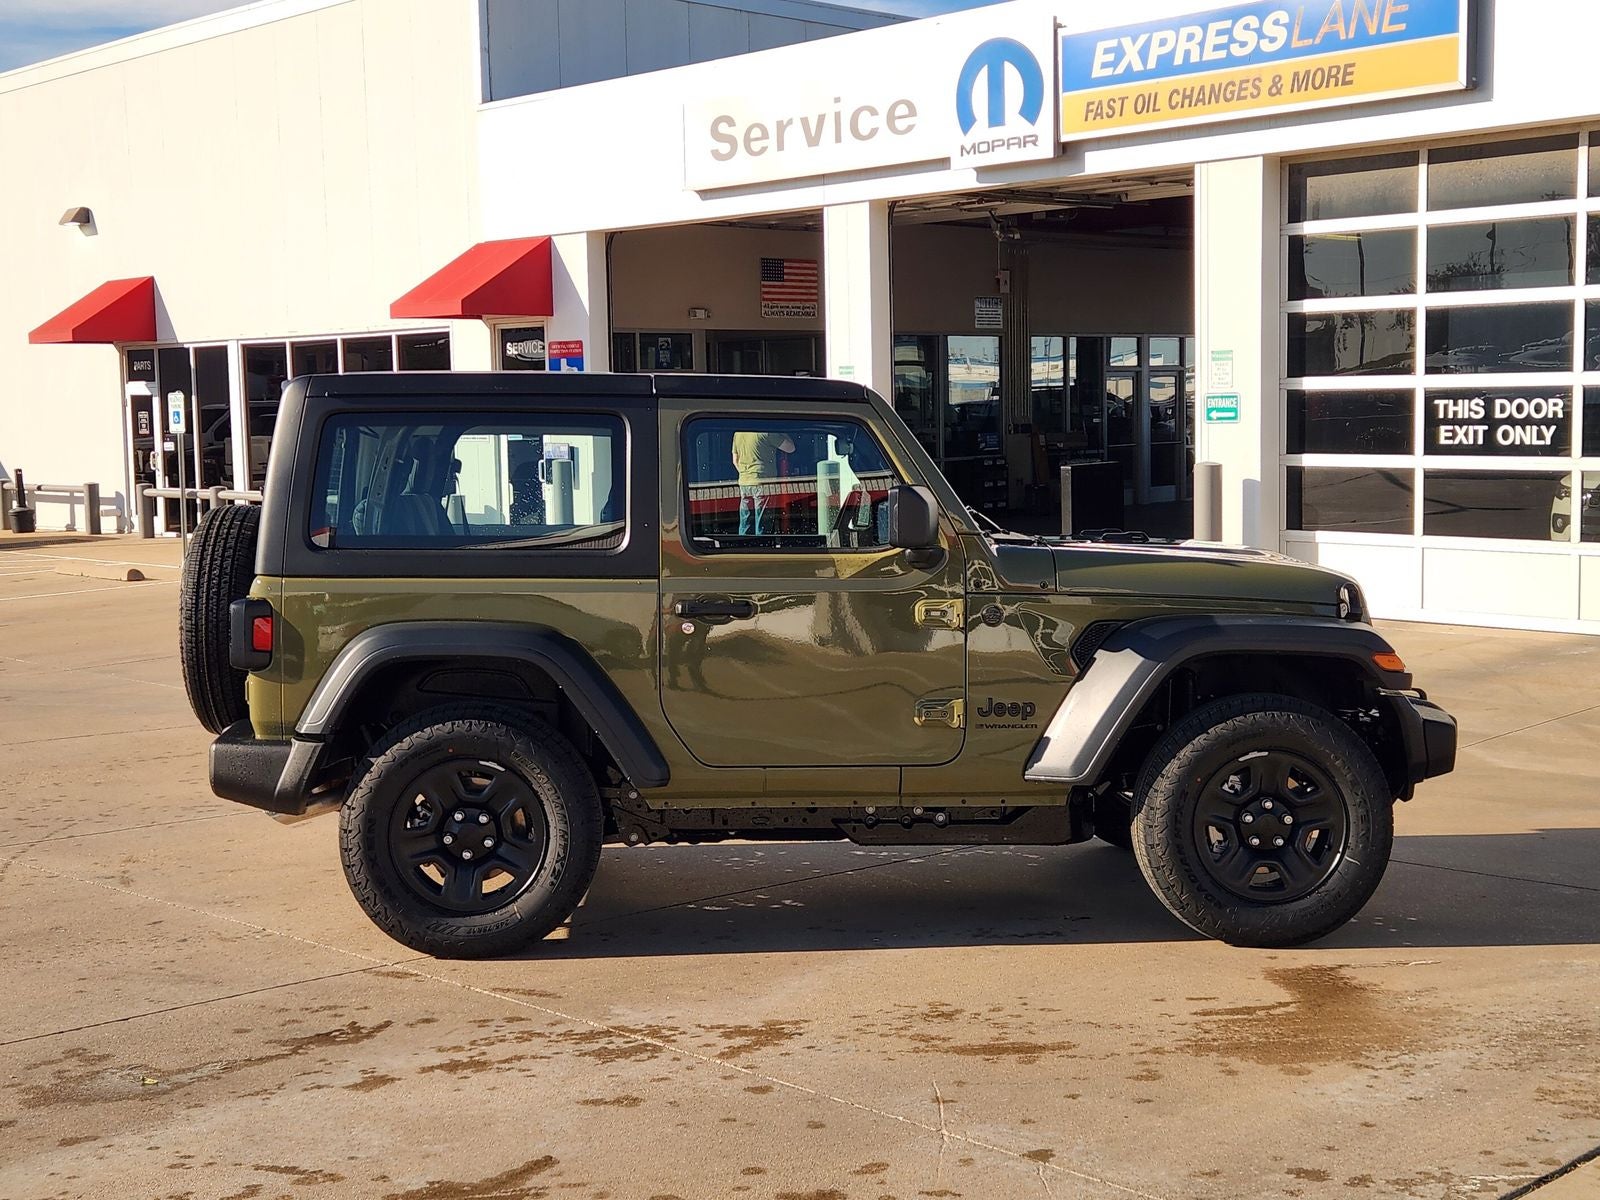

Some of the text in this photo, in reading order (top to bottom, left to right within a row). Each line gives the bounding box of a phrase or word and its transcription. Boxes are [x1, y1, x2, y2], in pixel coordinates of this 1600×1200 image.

[1084, 63, 1356, 122] FAST OIL CHANGES & MORE
[710, 96, 918, 162] Service
[960, 134, 1039, 157] MOPAR
[506, 340, 544, 354] SERVICE
[134, 361, 151, 371] PARTS
[1208, 398, 1237, 408] ENTRANCE
[1434, 397, 1564, 419] THIS DOOR
[1439, 425, 1557, 446] EXIT ONLY
[977, 697, 1036, 720] Jeep
